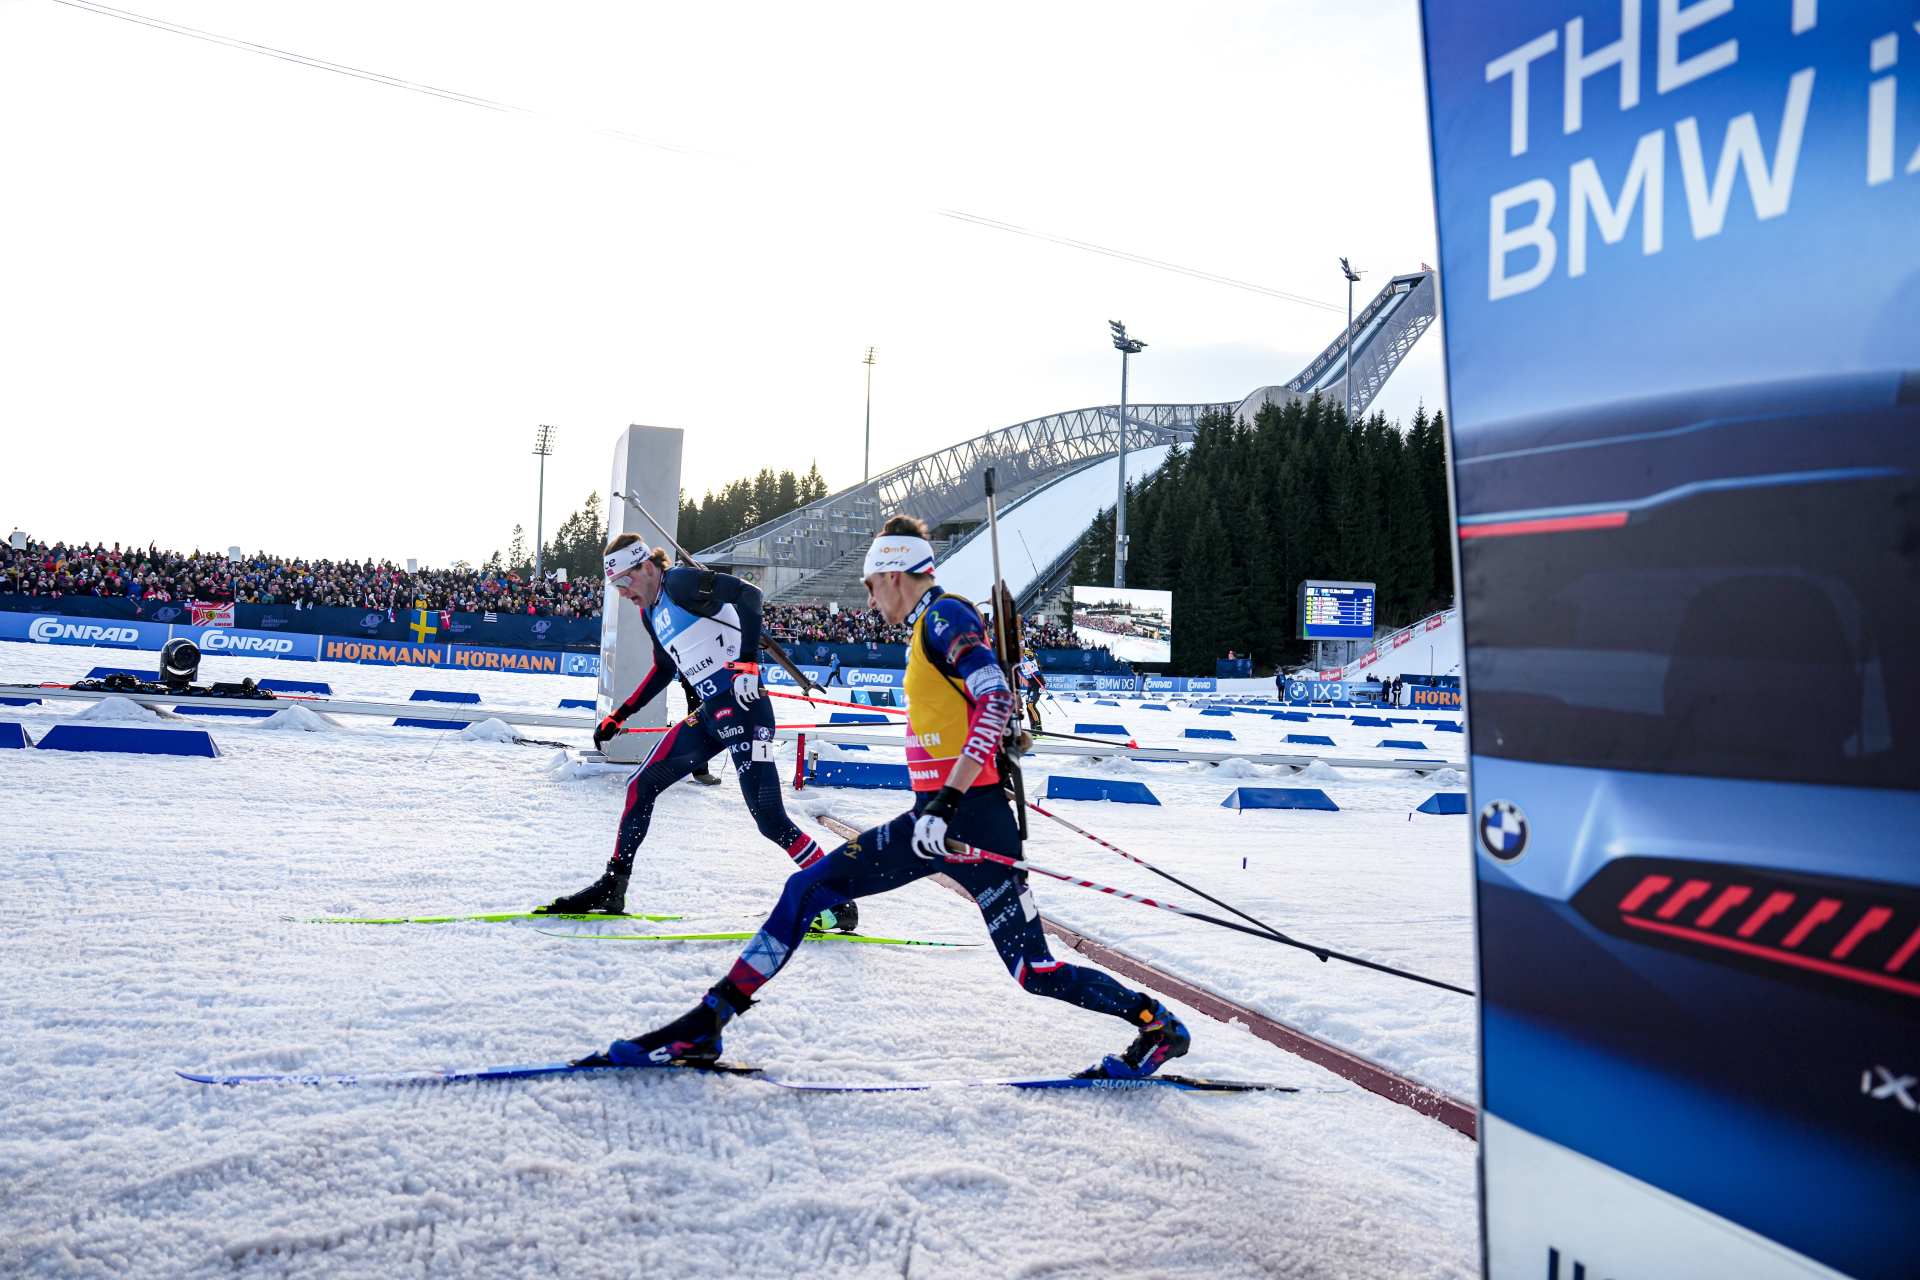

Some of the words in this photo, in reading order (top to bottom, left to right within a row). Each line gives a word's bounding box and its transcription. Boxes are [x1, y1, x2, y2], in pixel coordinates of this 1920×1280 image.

[1485, 0, 1739, 158] THE
[1488, 67, 1817, 302] BMW
[29, 617, 139, 642] CONRAD
[200, 630, 294, 653] CONRAD
[326, 641, 442, 664] HÖRMANN
[455, 650, 557, 672] HÖRMANN
[847, 669, 893, 685] CONRAD
[1100, 678, 1120, 689] BMW
[1313, 683, 1342, 699] iX3
[963, 692, 1012, 765] FRANCE
[761, 744, 767, 759] 1
[1860, 1064, 1920, 1112] iX
